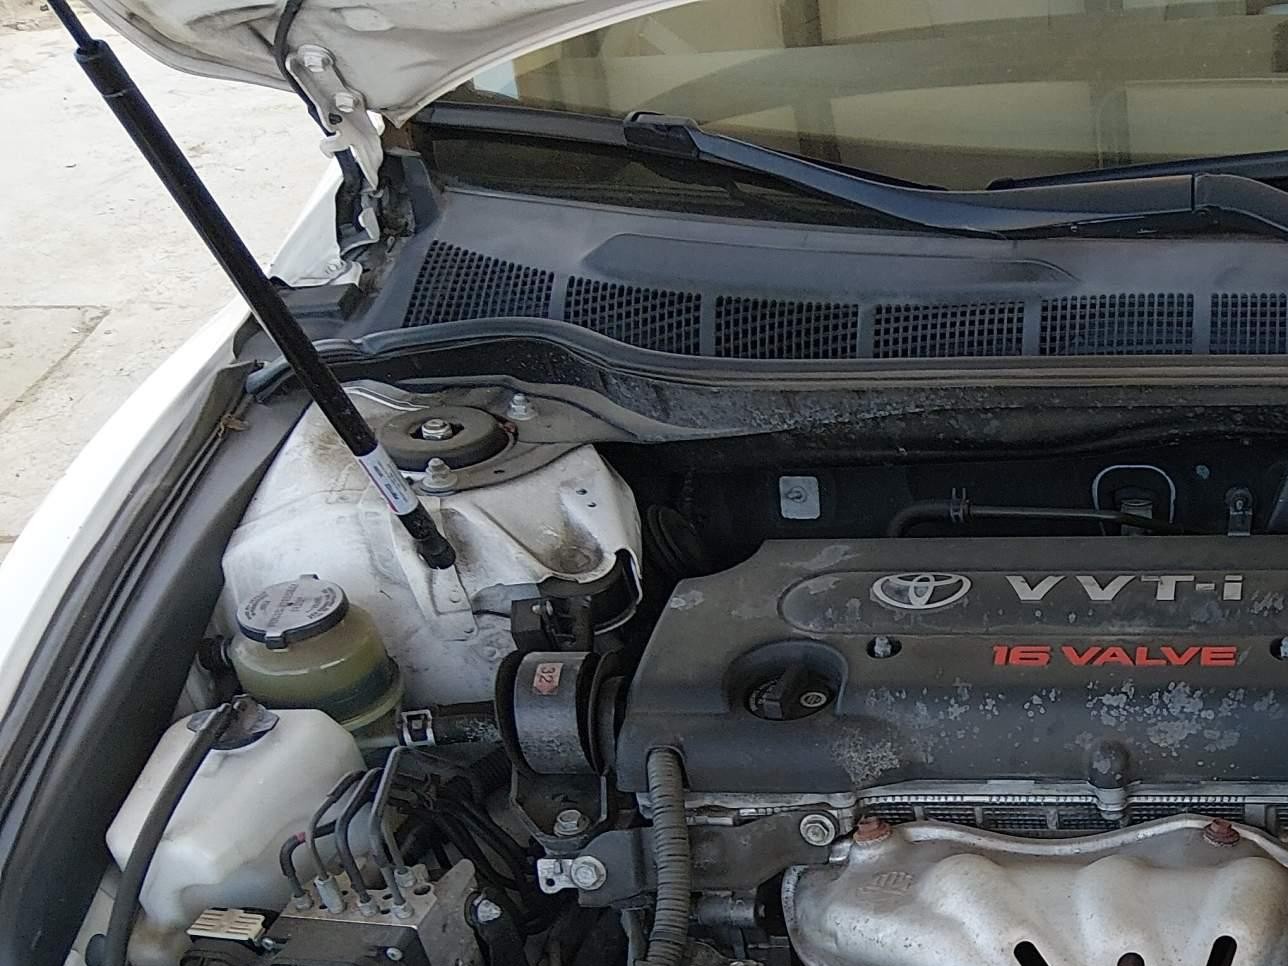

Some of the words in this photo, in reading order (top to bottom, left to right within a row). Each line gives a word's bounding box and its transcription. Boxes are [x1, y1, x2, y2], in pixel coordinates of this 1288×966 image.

[1006, 574, 1244, 601] VVT-i
[993, 645, 1052, 667] 16
[1061, 645, 1237, 667] VALVE
[539, 667, 556, 683] 32
